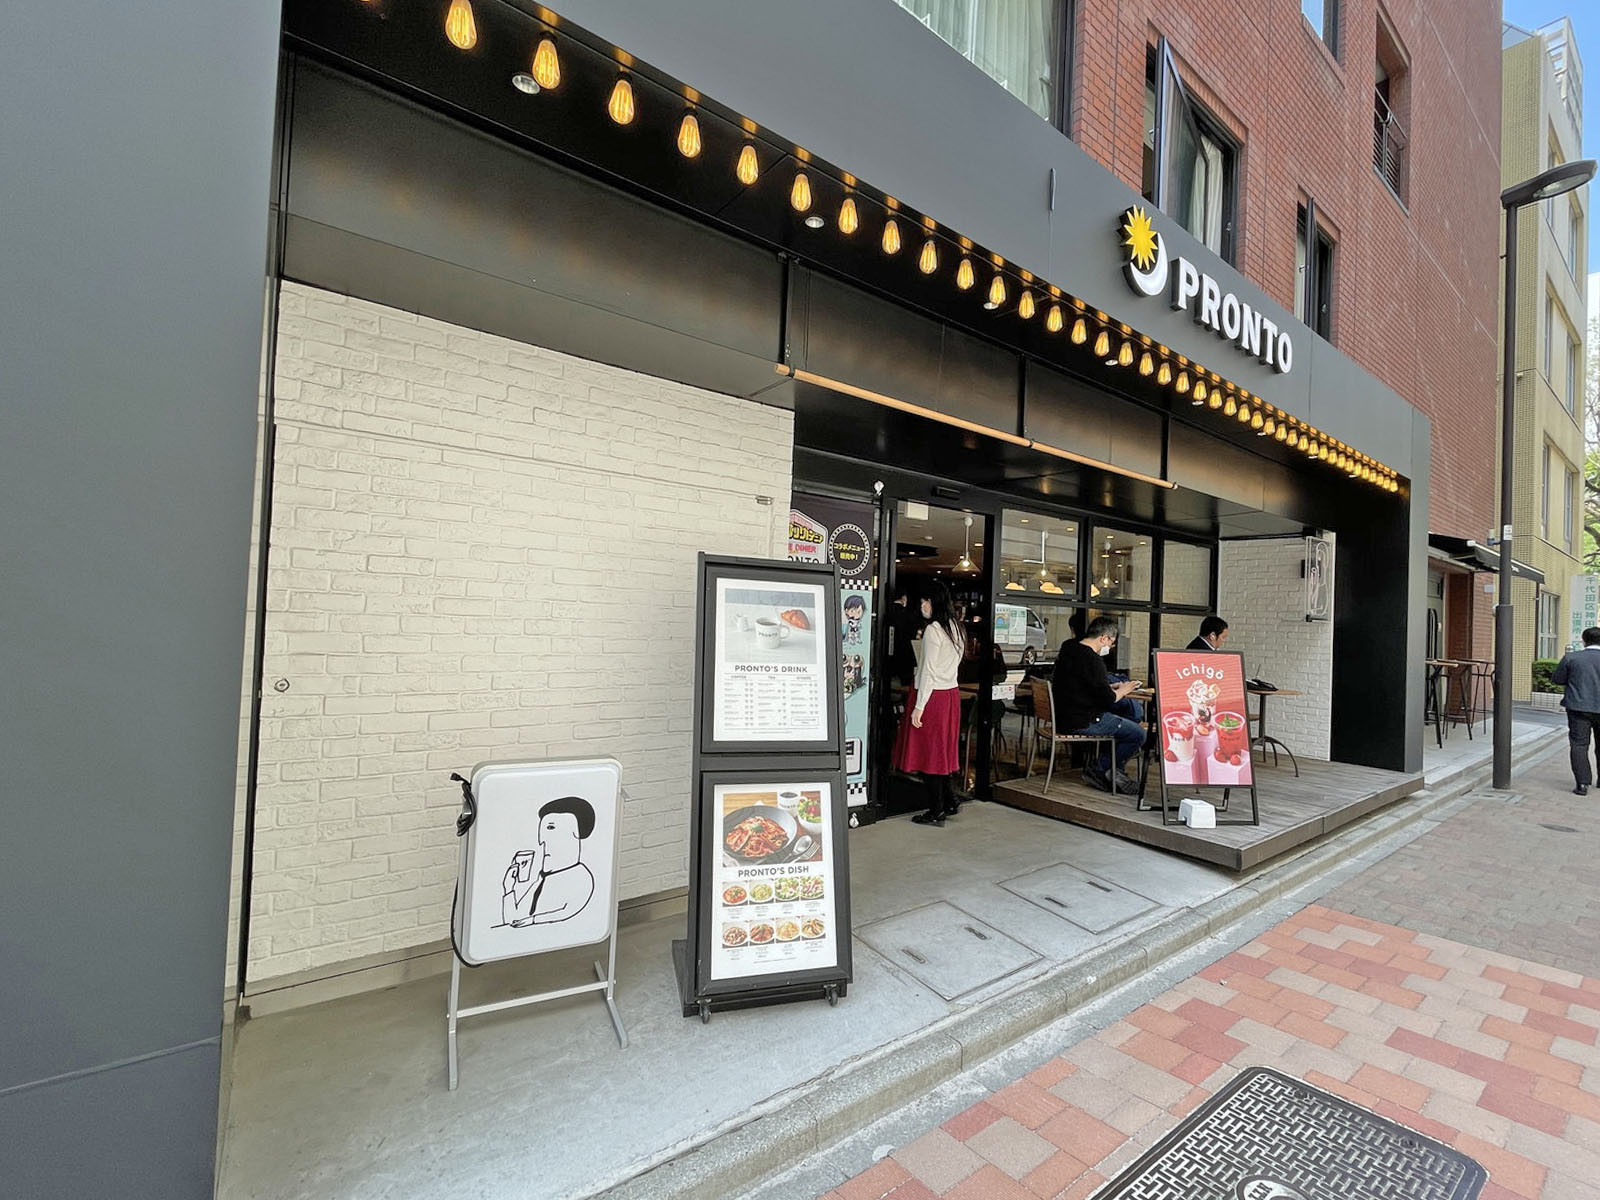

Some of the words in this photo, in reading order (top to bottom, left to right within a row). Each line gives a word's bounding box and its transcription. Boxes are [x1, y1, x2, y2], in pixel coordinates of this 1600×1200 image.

[1175, 257, 1292, 373] PRONTO
[738, 867, 785, 877] PRONTO'S
[788, 866, 809, 874] DISH
